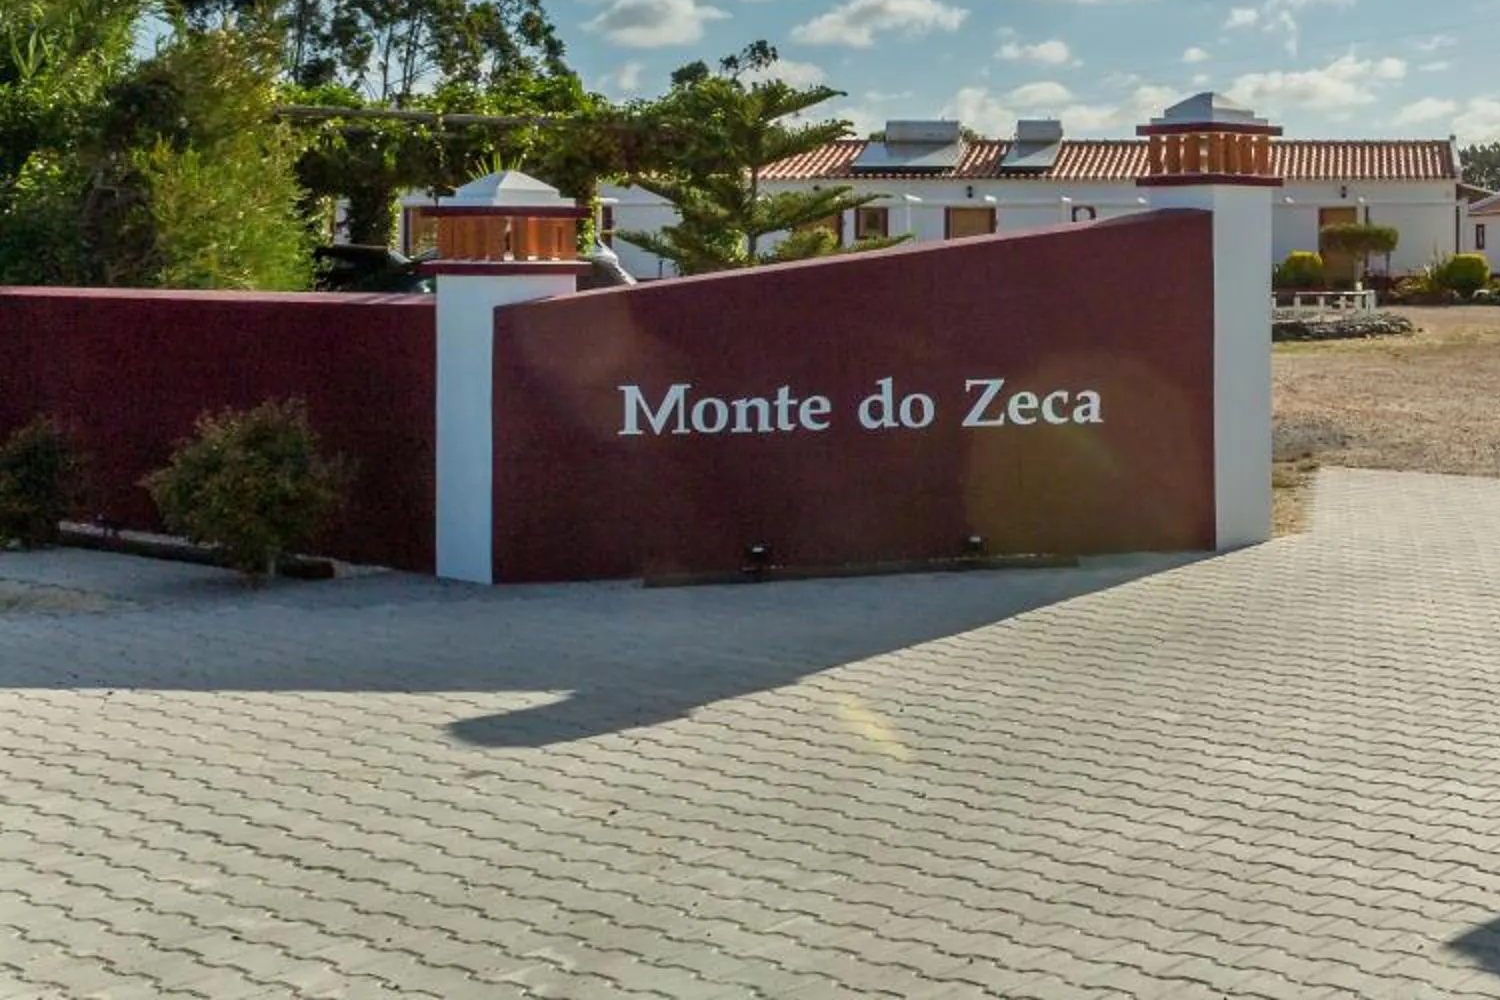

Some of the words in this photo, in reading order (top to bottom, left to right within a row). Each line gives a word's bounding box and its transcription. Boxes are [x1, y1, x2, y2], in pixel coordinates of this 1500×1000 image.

[617, 383, 832, 435] Monte
[858, 377, 935, 428] do
[962, 378, 1104, 427] Zeca
